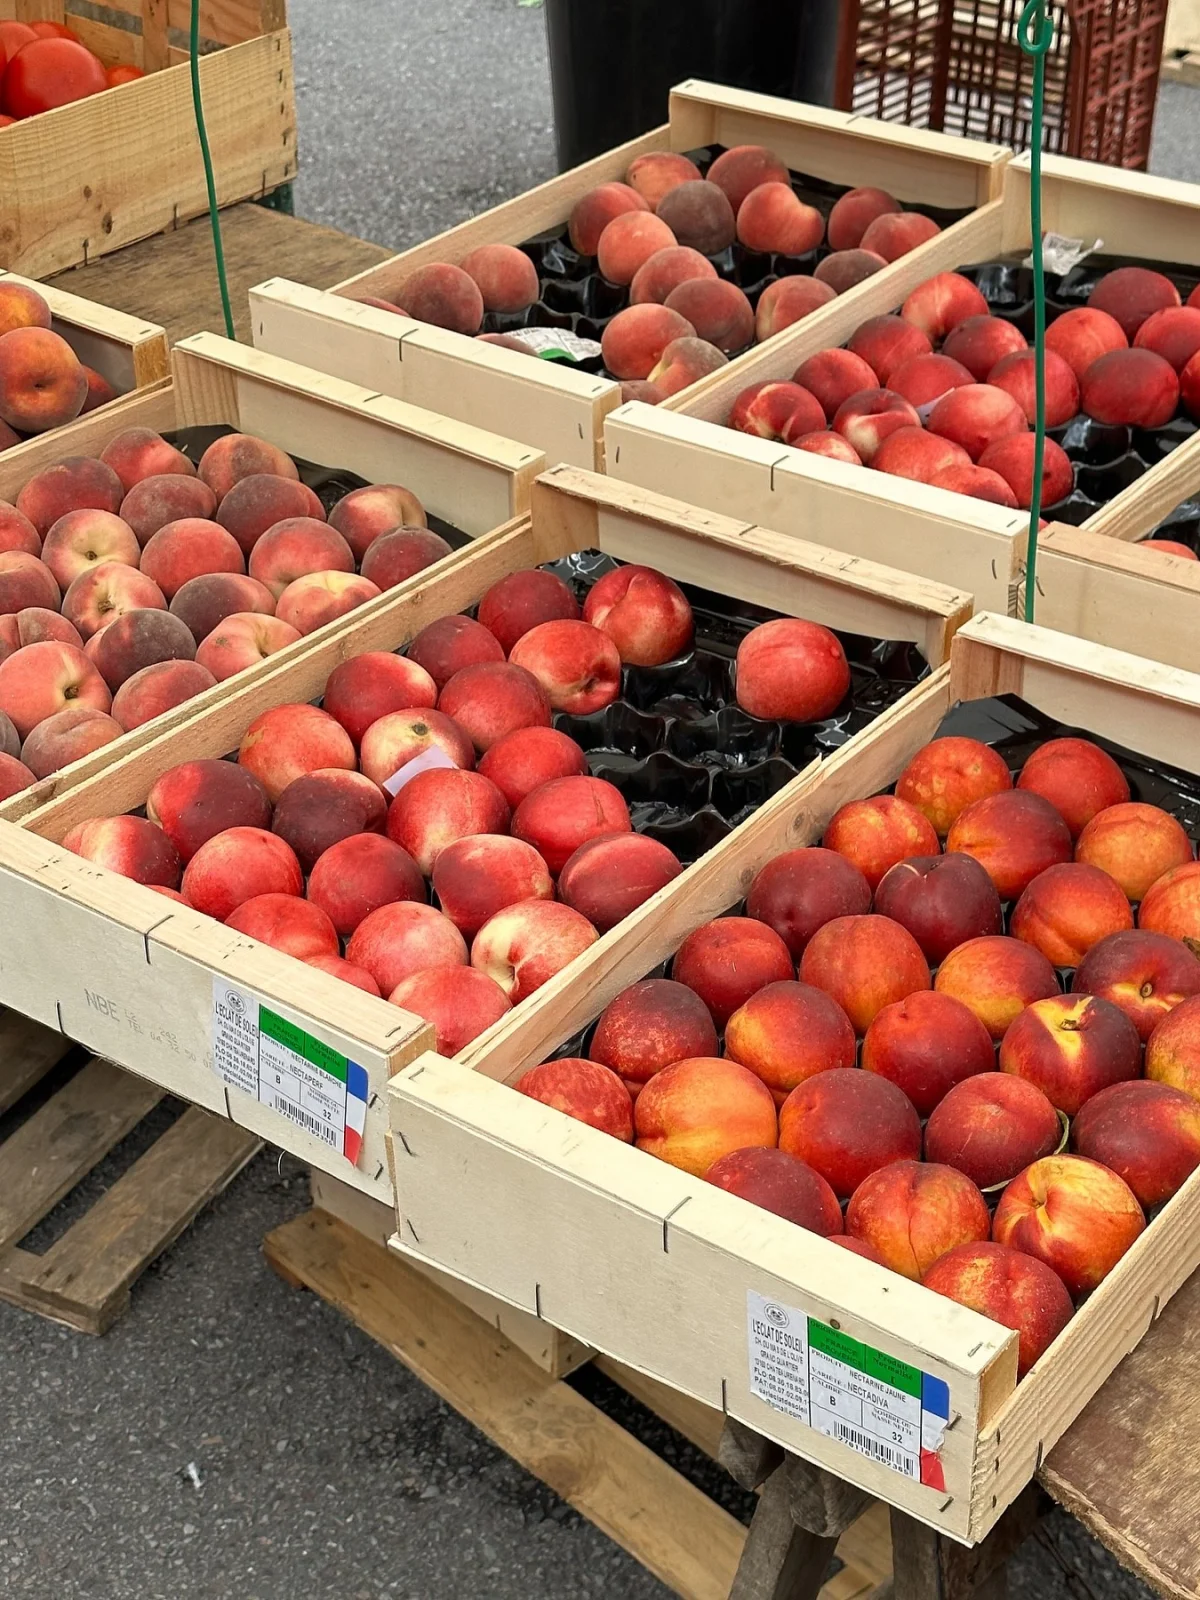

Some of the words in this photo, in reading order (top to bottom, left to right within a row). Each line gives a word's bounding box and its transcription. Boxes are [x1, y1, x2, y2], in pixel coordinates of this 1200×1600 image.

[84, 988, 120, 1022] NBE
[275, 1073, 281, 1085] B
[322, 1108, 331, 1121] 32
[775, 1328, 783, 1345] DE
[783, 1332, 803, 1354] SOLEIL
[847, 1380, 888, 1410] NECTADIVA
[849, 1368, 885, 1393] NECTARINE
[885, 1386, 906, 1403] JAUNE
[829, 1395, 836, 1407] B
[891, 1430, 903, 1444] 32
